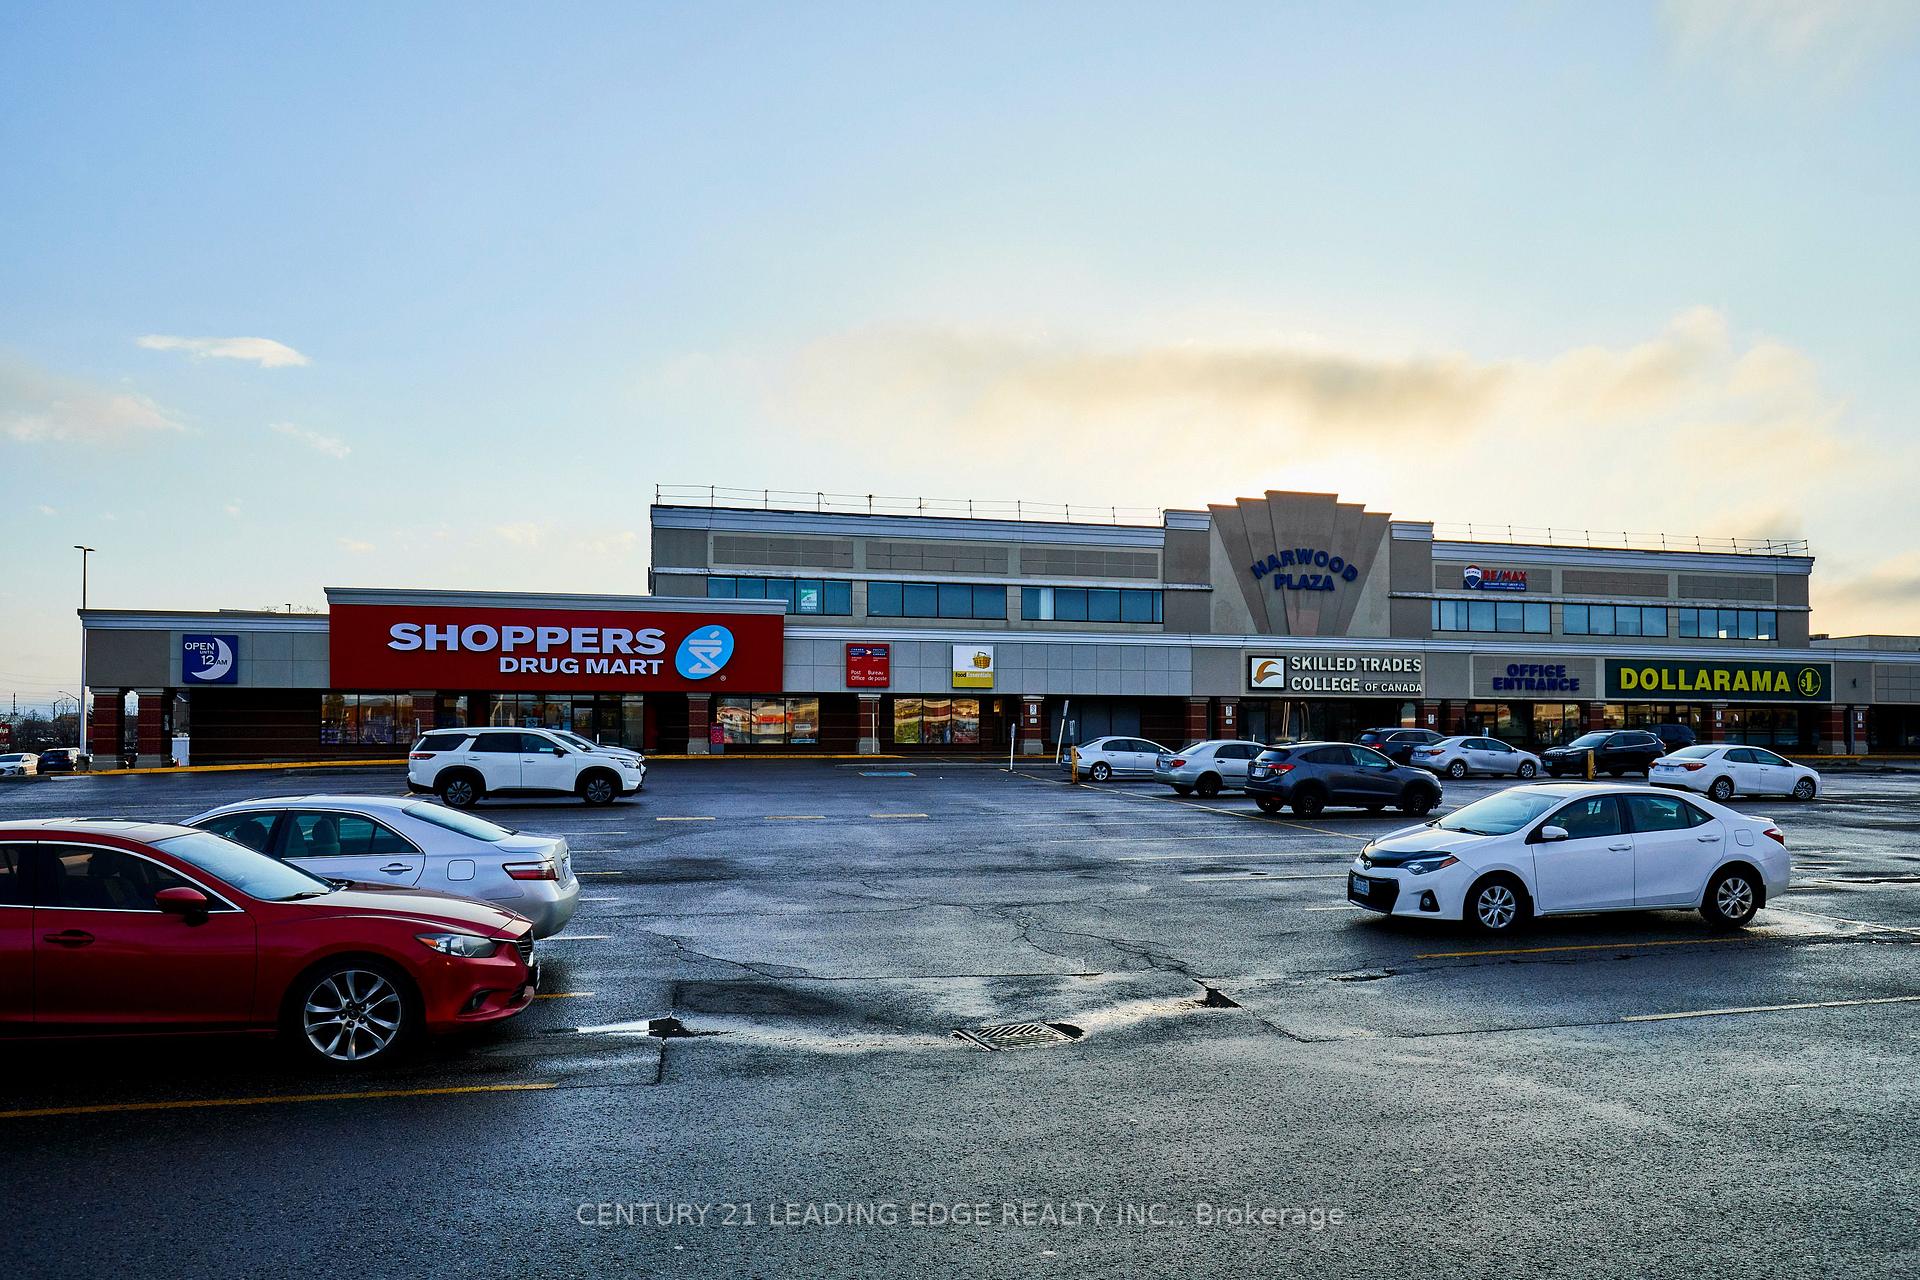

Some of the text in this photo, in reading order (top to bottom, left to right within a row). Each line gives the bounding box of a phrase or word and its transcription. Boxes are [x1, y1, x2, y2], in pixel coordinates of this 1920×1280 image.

[1251, 549, 1358, 582] HARWOOD
[1274, 574, 1335, 591] PLAZA
[1482, 569, 1527, 581] RE/MAX
[184, 642, 215, 650] OPEN
[387, 622, 666, 655] SHOPPERS
[201, 654, 215, 665] 12
[500, 657, 664, 675] DRUG MART
[1291, 656, 1422, 672] SKILLED TRADES
[1506, 663, 1567, 679] OFFICE
[1291, 676, 1422, 692] COLLEGE OF CANADA
[1493, 677, 1580, 692] ENTRANCE
[1620, 667, 1791, 692] DOLLARAMA
